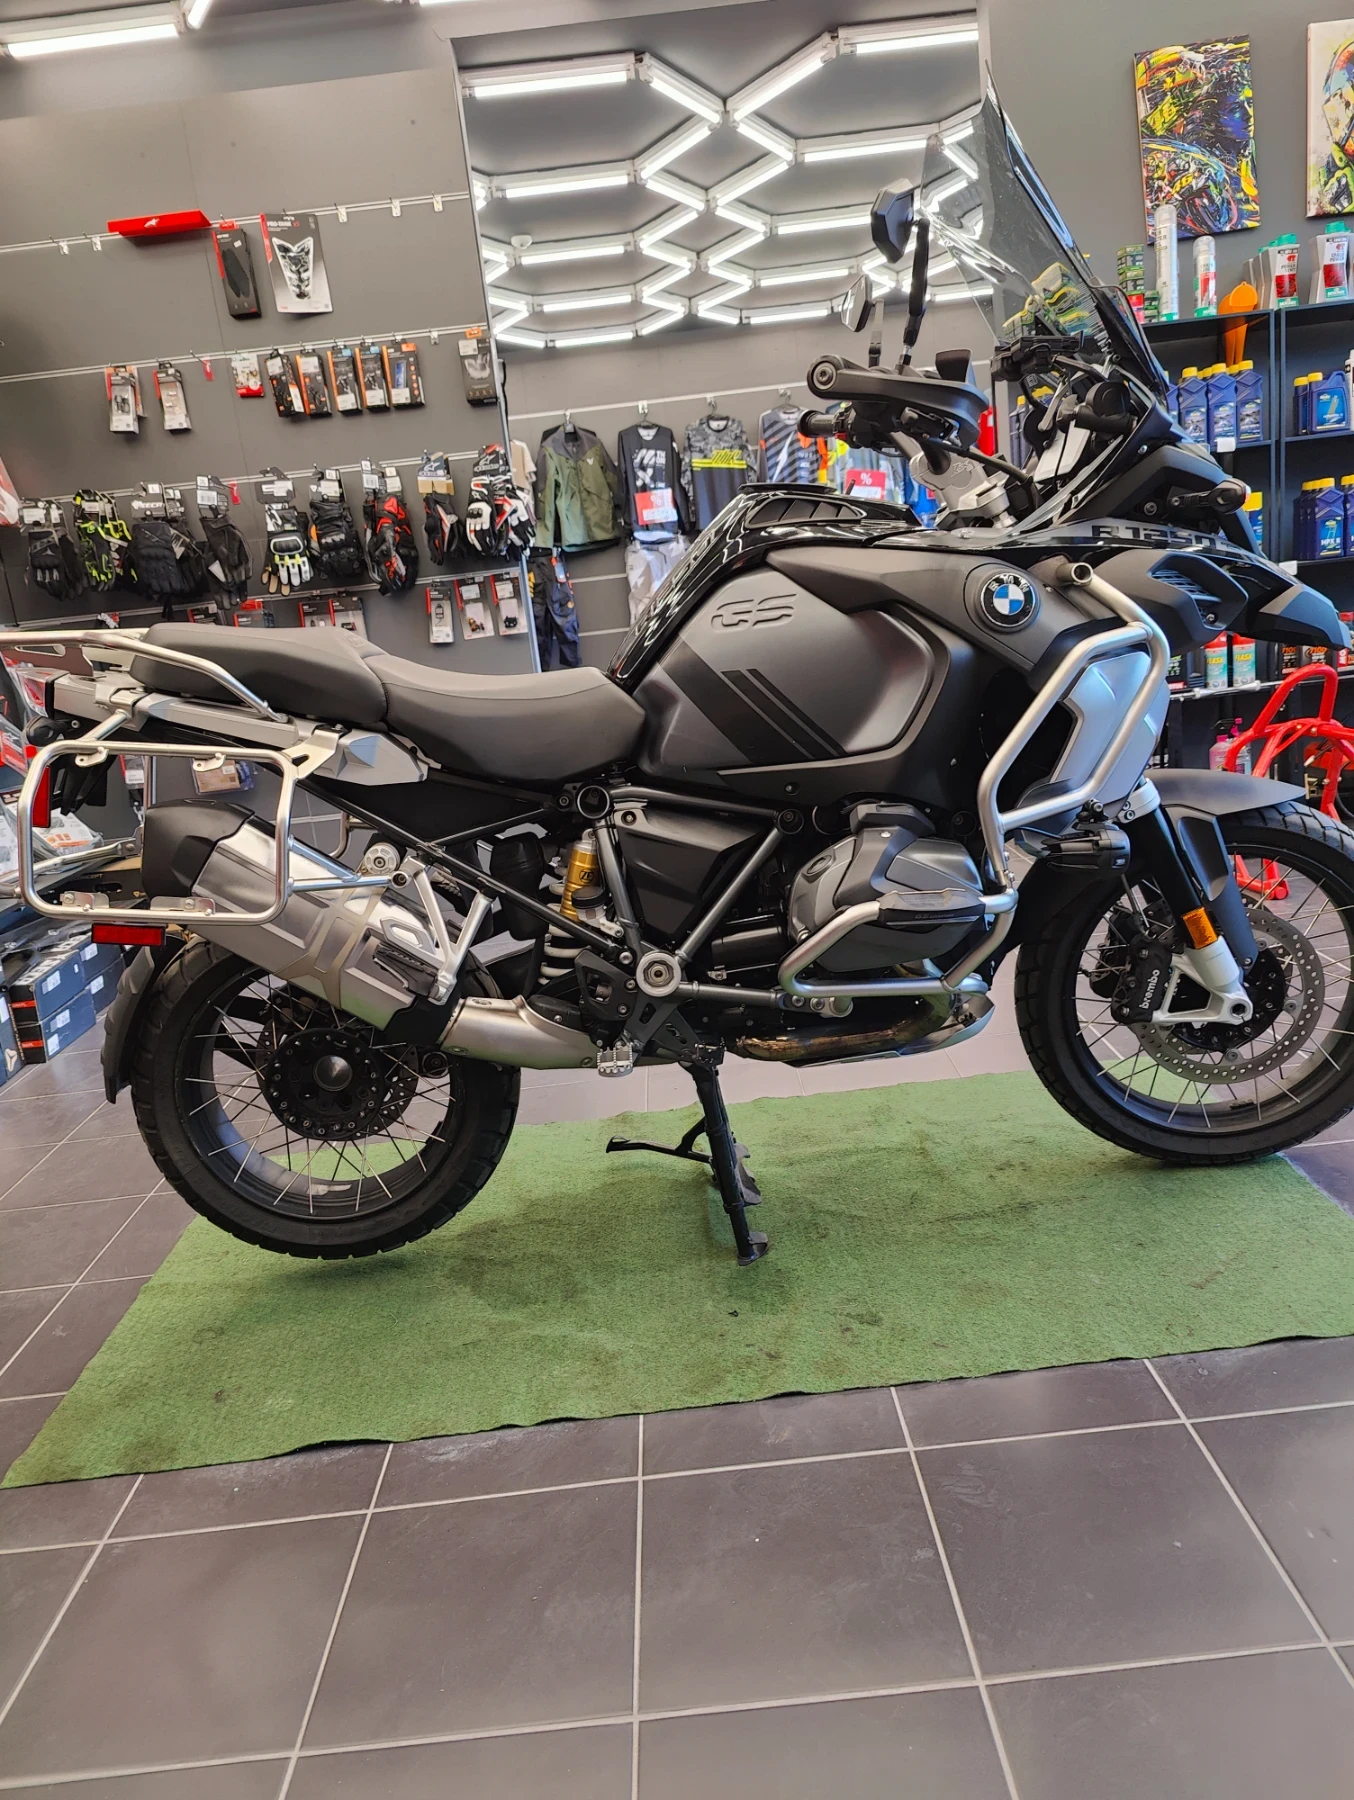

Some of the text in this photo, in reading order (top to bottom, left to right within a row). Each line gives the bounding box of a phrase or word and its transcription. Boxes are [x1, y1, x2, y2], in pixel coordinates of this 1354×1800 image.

[1125, 526, 1216, 549] 1250
[988, 573, 1031, 593] BMW
[711, 593, 797, 633] GS
[1138, 969, 1161, 1009] brembo
